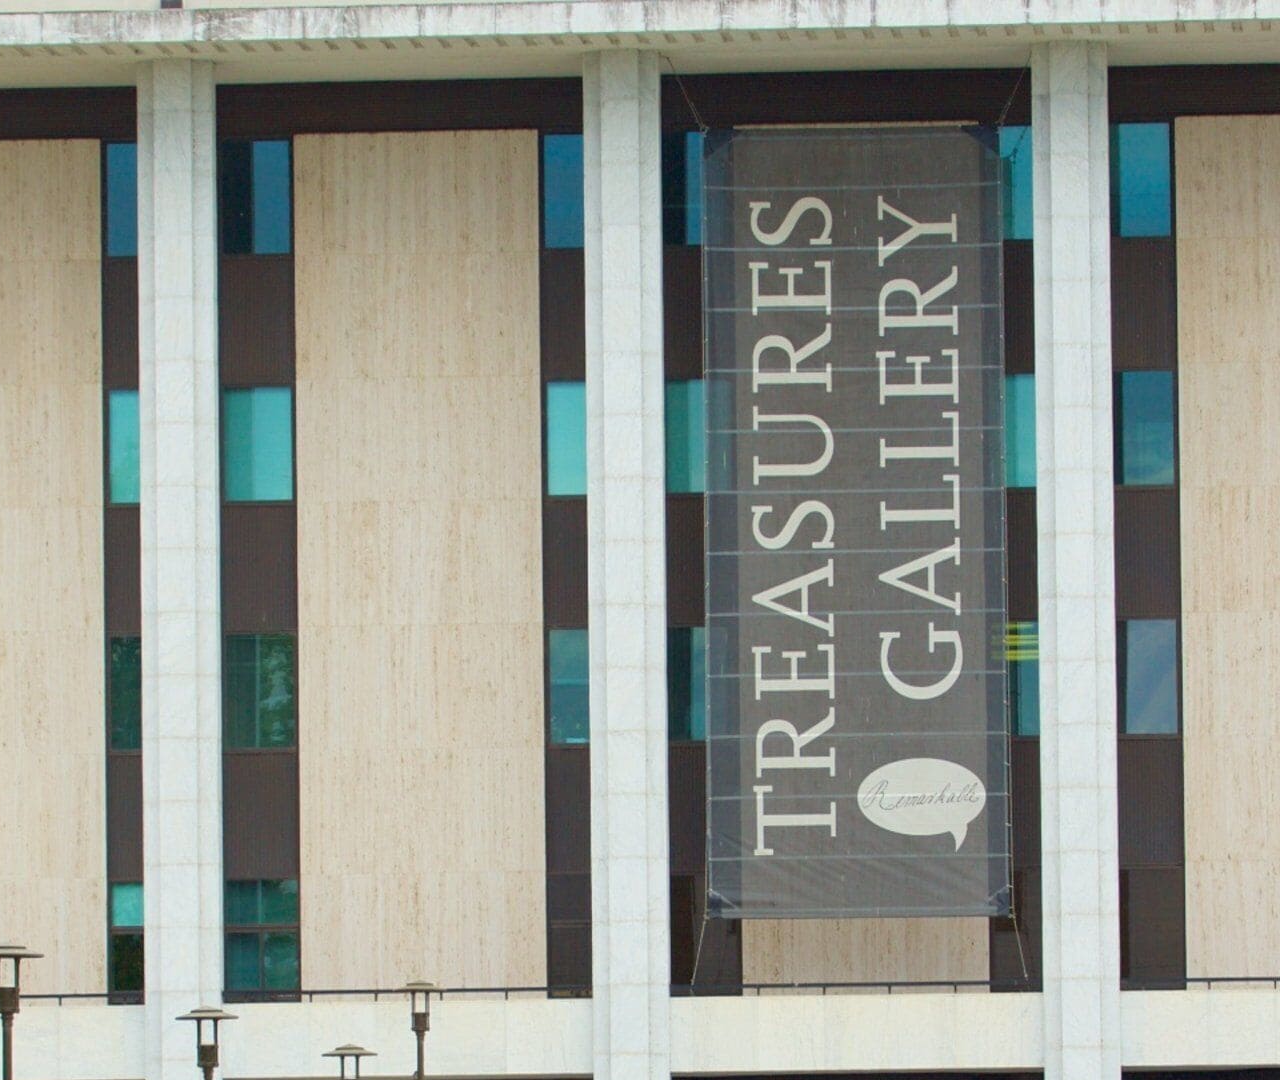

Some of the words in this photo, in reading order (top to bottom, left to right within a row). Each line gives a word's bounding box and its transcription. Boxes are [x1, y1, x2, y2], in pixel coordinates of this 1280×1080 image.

[750, 196, 838, 857] TREASURES
[877, 194, 964, 701] GALLERY
[863, 779, 980, 811] Remarkable
